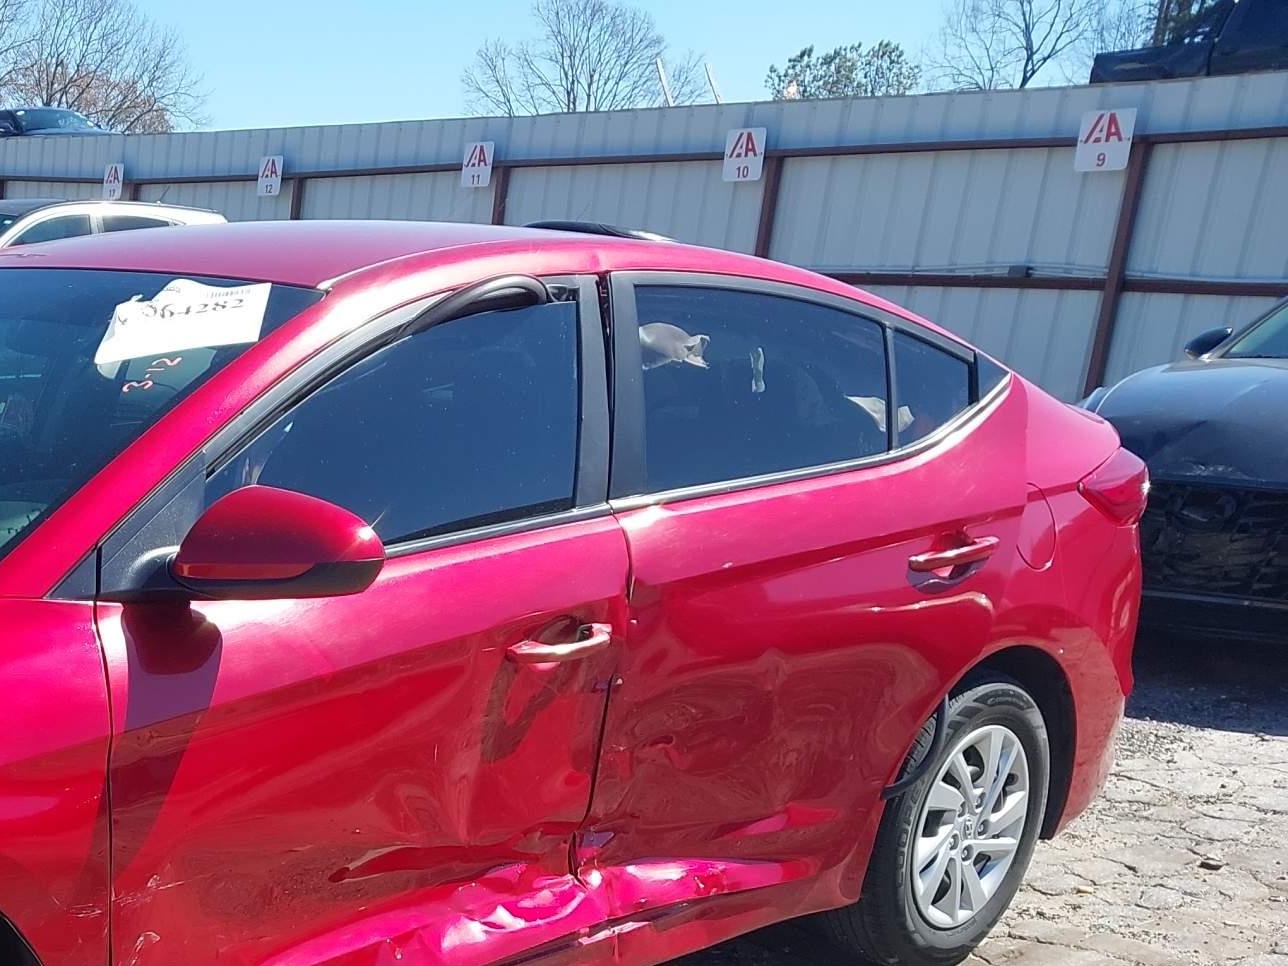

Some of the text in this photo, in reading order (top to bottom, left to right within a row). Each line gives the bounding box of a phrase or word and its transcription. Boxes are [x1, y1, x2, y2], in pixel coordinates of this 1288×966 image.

[1096, 151, 1107, 168] 9
[735, 165, 750, 179] 10
[471, 174, 481, 185] 11
[264, 183, 273, 194] 12
